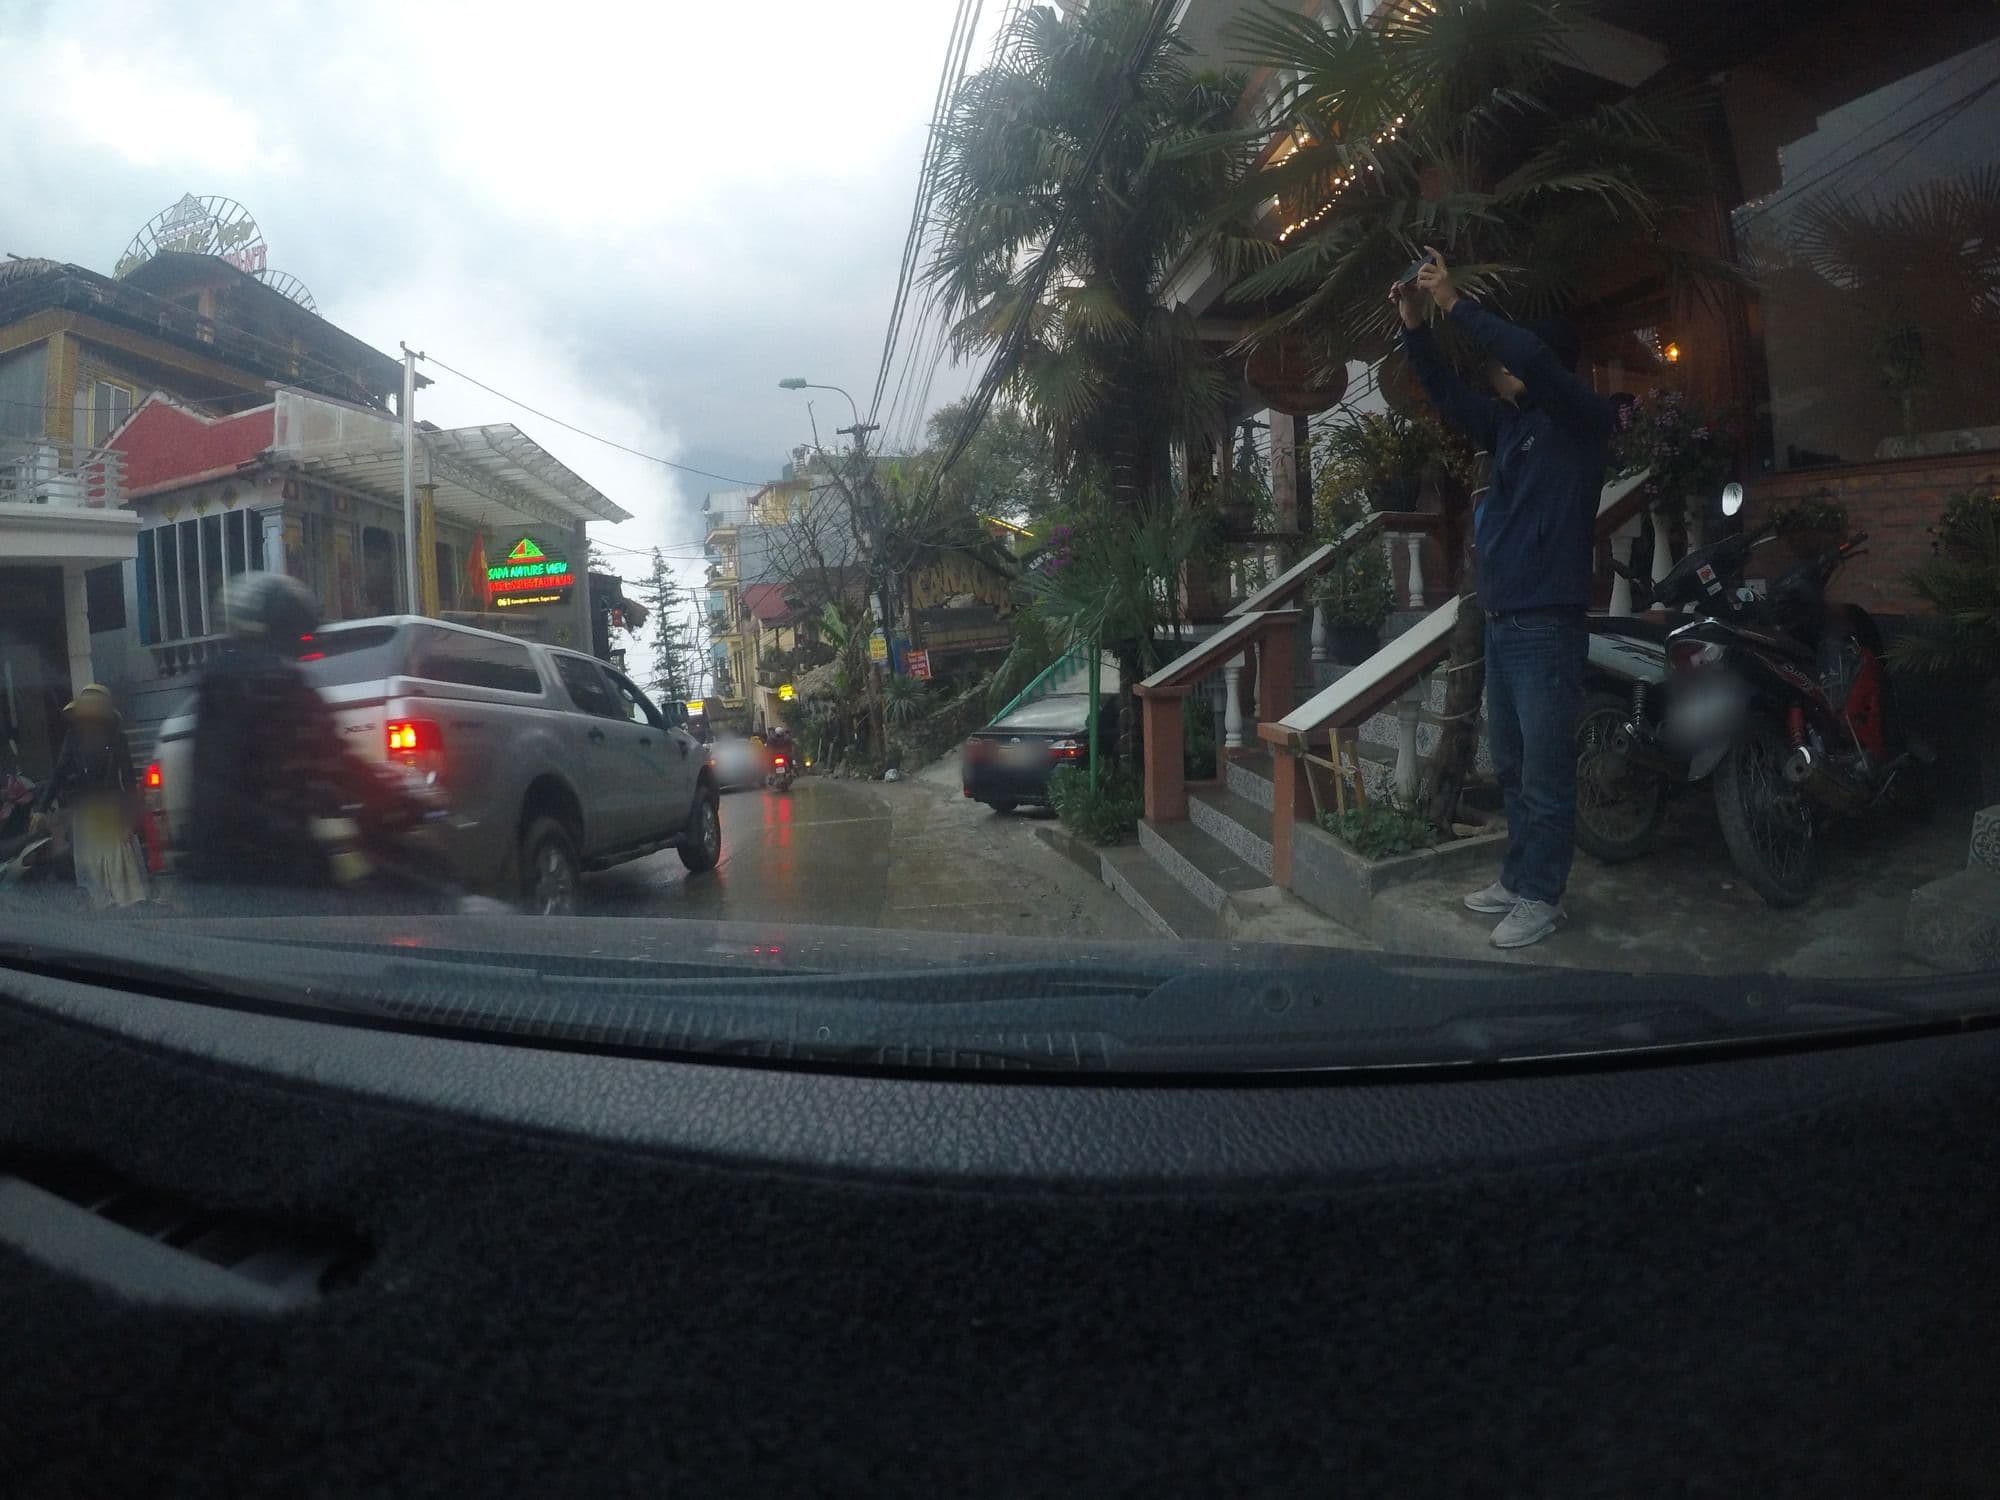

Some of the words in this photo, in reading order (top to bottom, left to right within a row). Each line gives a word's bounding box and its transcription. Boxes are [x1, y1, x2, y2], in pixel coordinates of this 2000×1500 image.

[488, 566, 508, 580] SAPA
[510, 563, 544, 578] NATURE
[546, 561, 567, 575] VIEW
